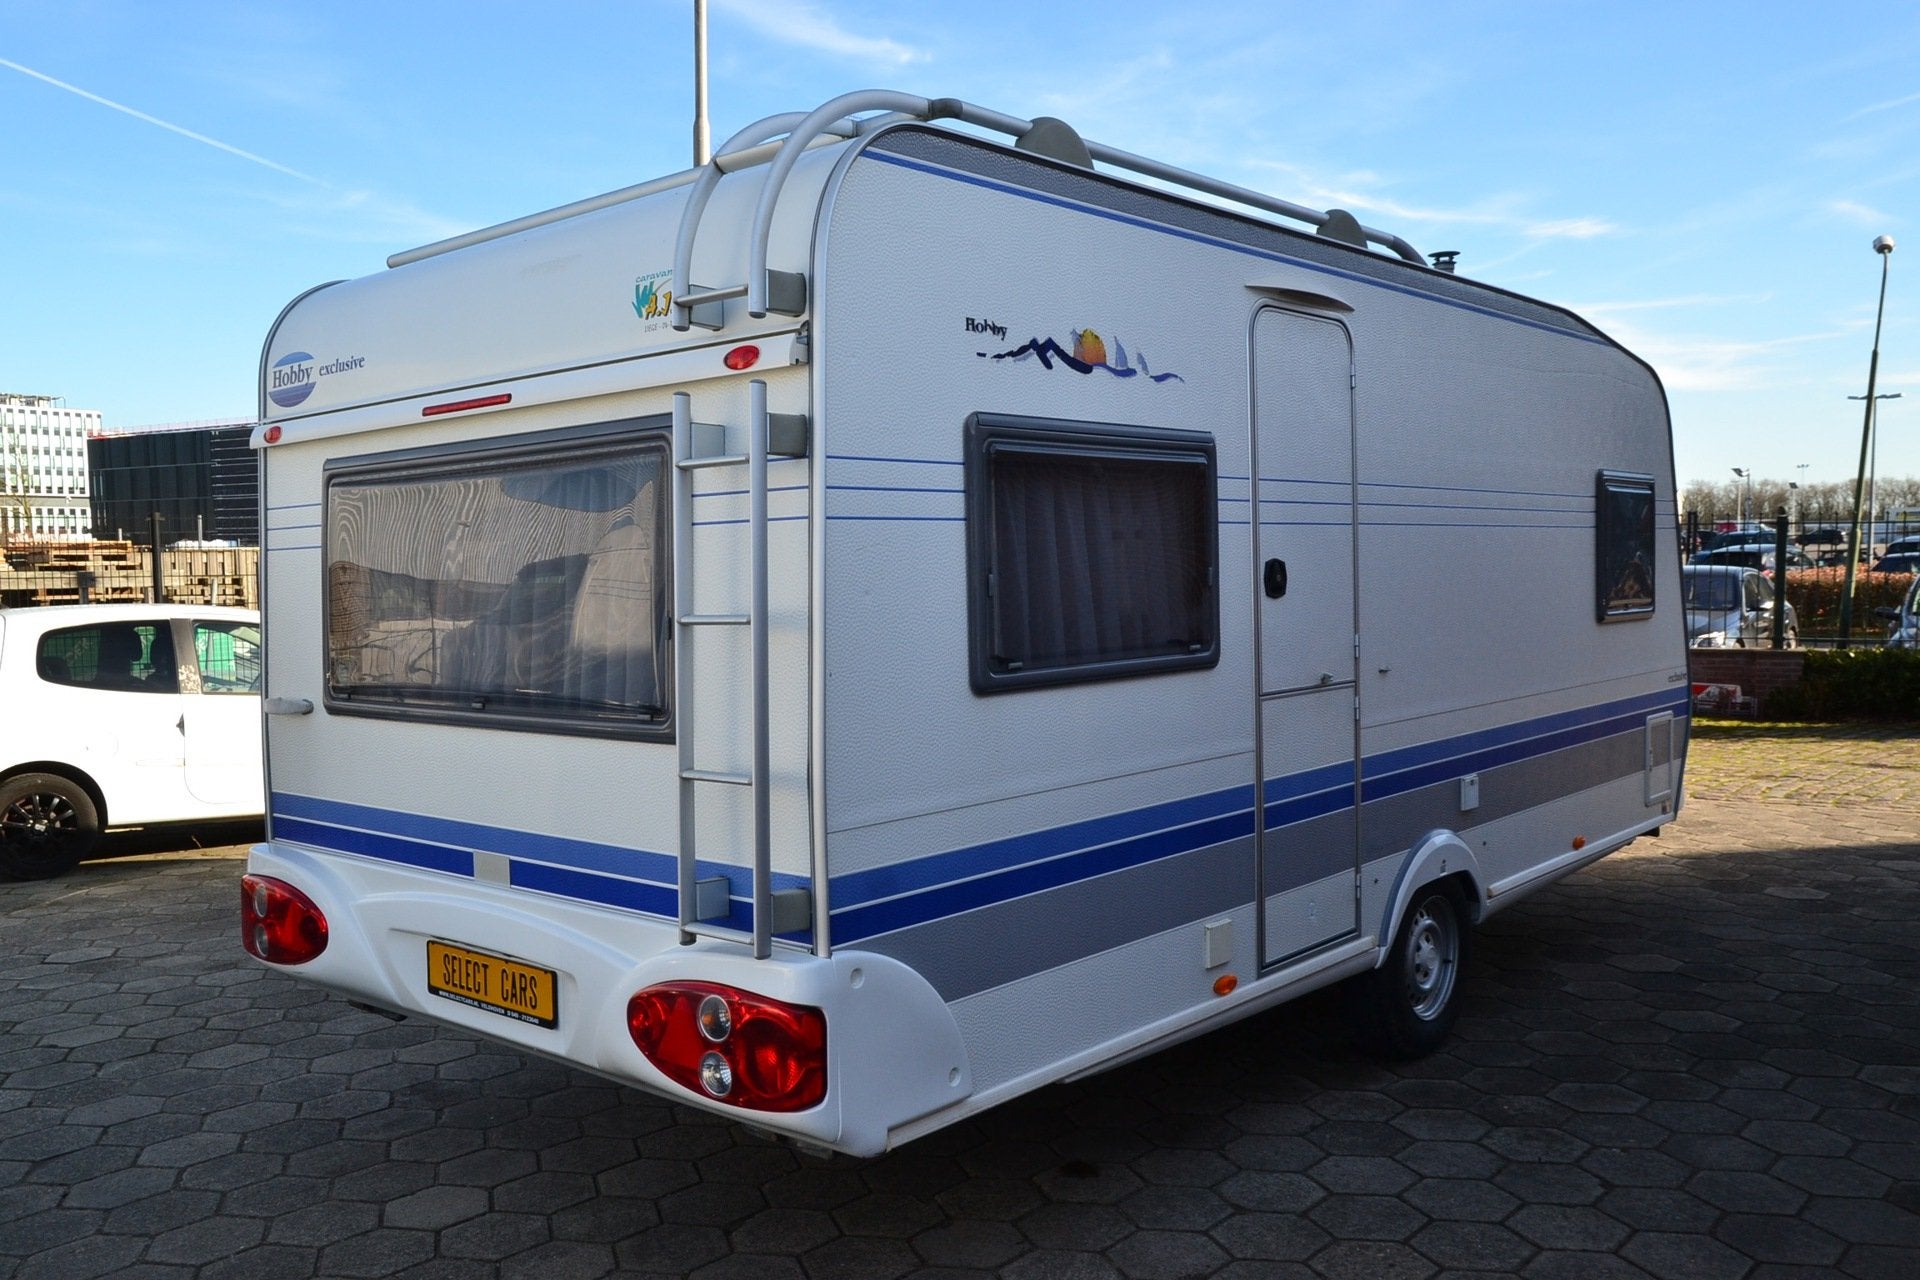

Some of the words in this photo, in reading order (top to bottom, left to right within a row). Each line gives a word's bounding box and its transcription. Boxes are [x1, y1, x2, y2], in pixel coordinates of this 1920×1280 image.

[965, 317, 1008, 341] Hobby
[272, 364, 314, 389] Hobby
[318, 355, 366, 377] exclusive
[443, 953, 489, 997] SELECT
[501, 968, 538, 1010] CARS
